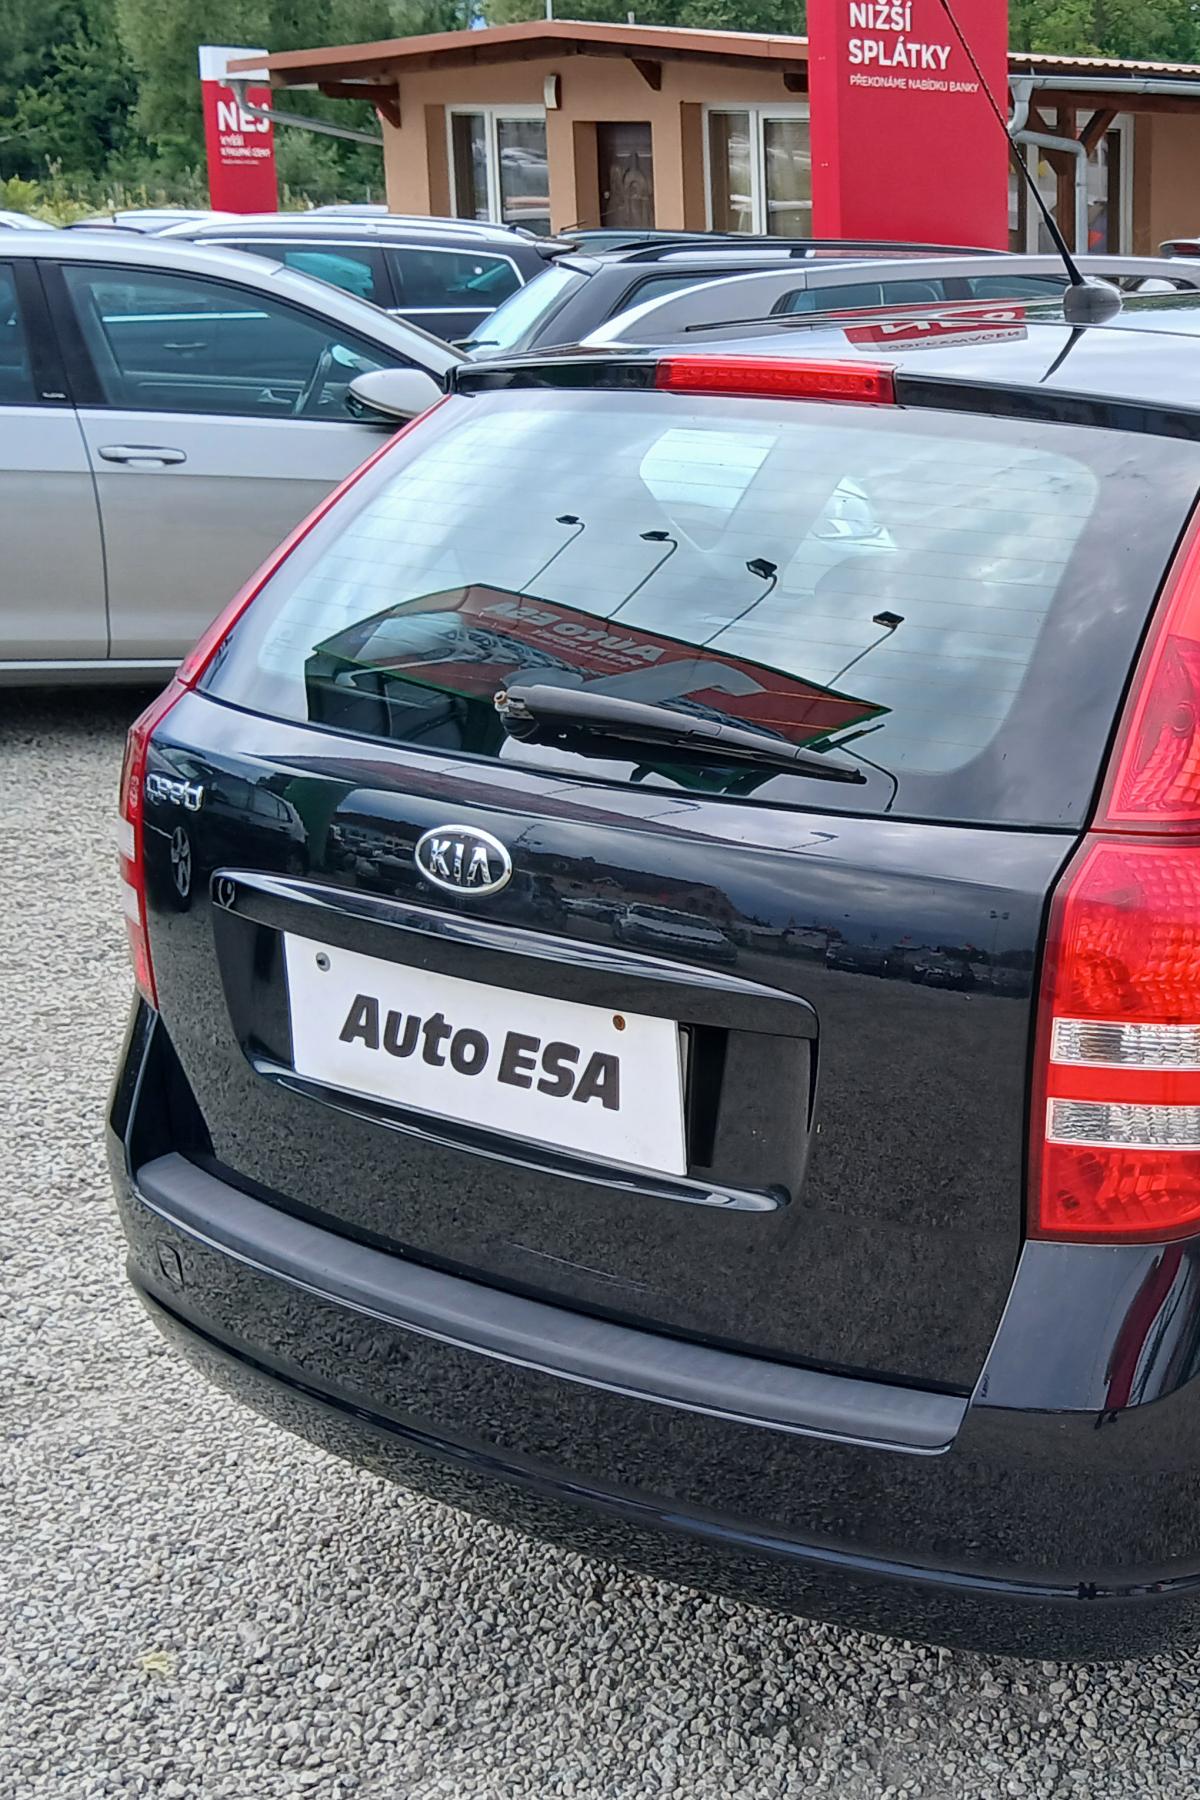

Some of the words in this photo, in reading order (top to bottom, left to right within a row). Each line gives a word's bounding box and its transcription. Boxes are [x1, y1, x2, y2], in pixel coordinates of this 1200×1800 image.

[849, 0, 912, 32] NIŽŠÍ
[848, 36, 951, 70] SPLÁTKY
[849, 73, 907, 89] PŘEKONÁME
[908, 77, 948, 92] NABÍDKU
[949, 80, 979, 93] BANKY
[217, 100, 270, 133] NEJ
[427, 837, 493, 884] KIA
[338, 993, 489, 1076] Auto
[497, 1031, 620, 1111] ESA
